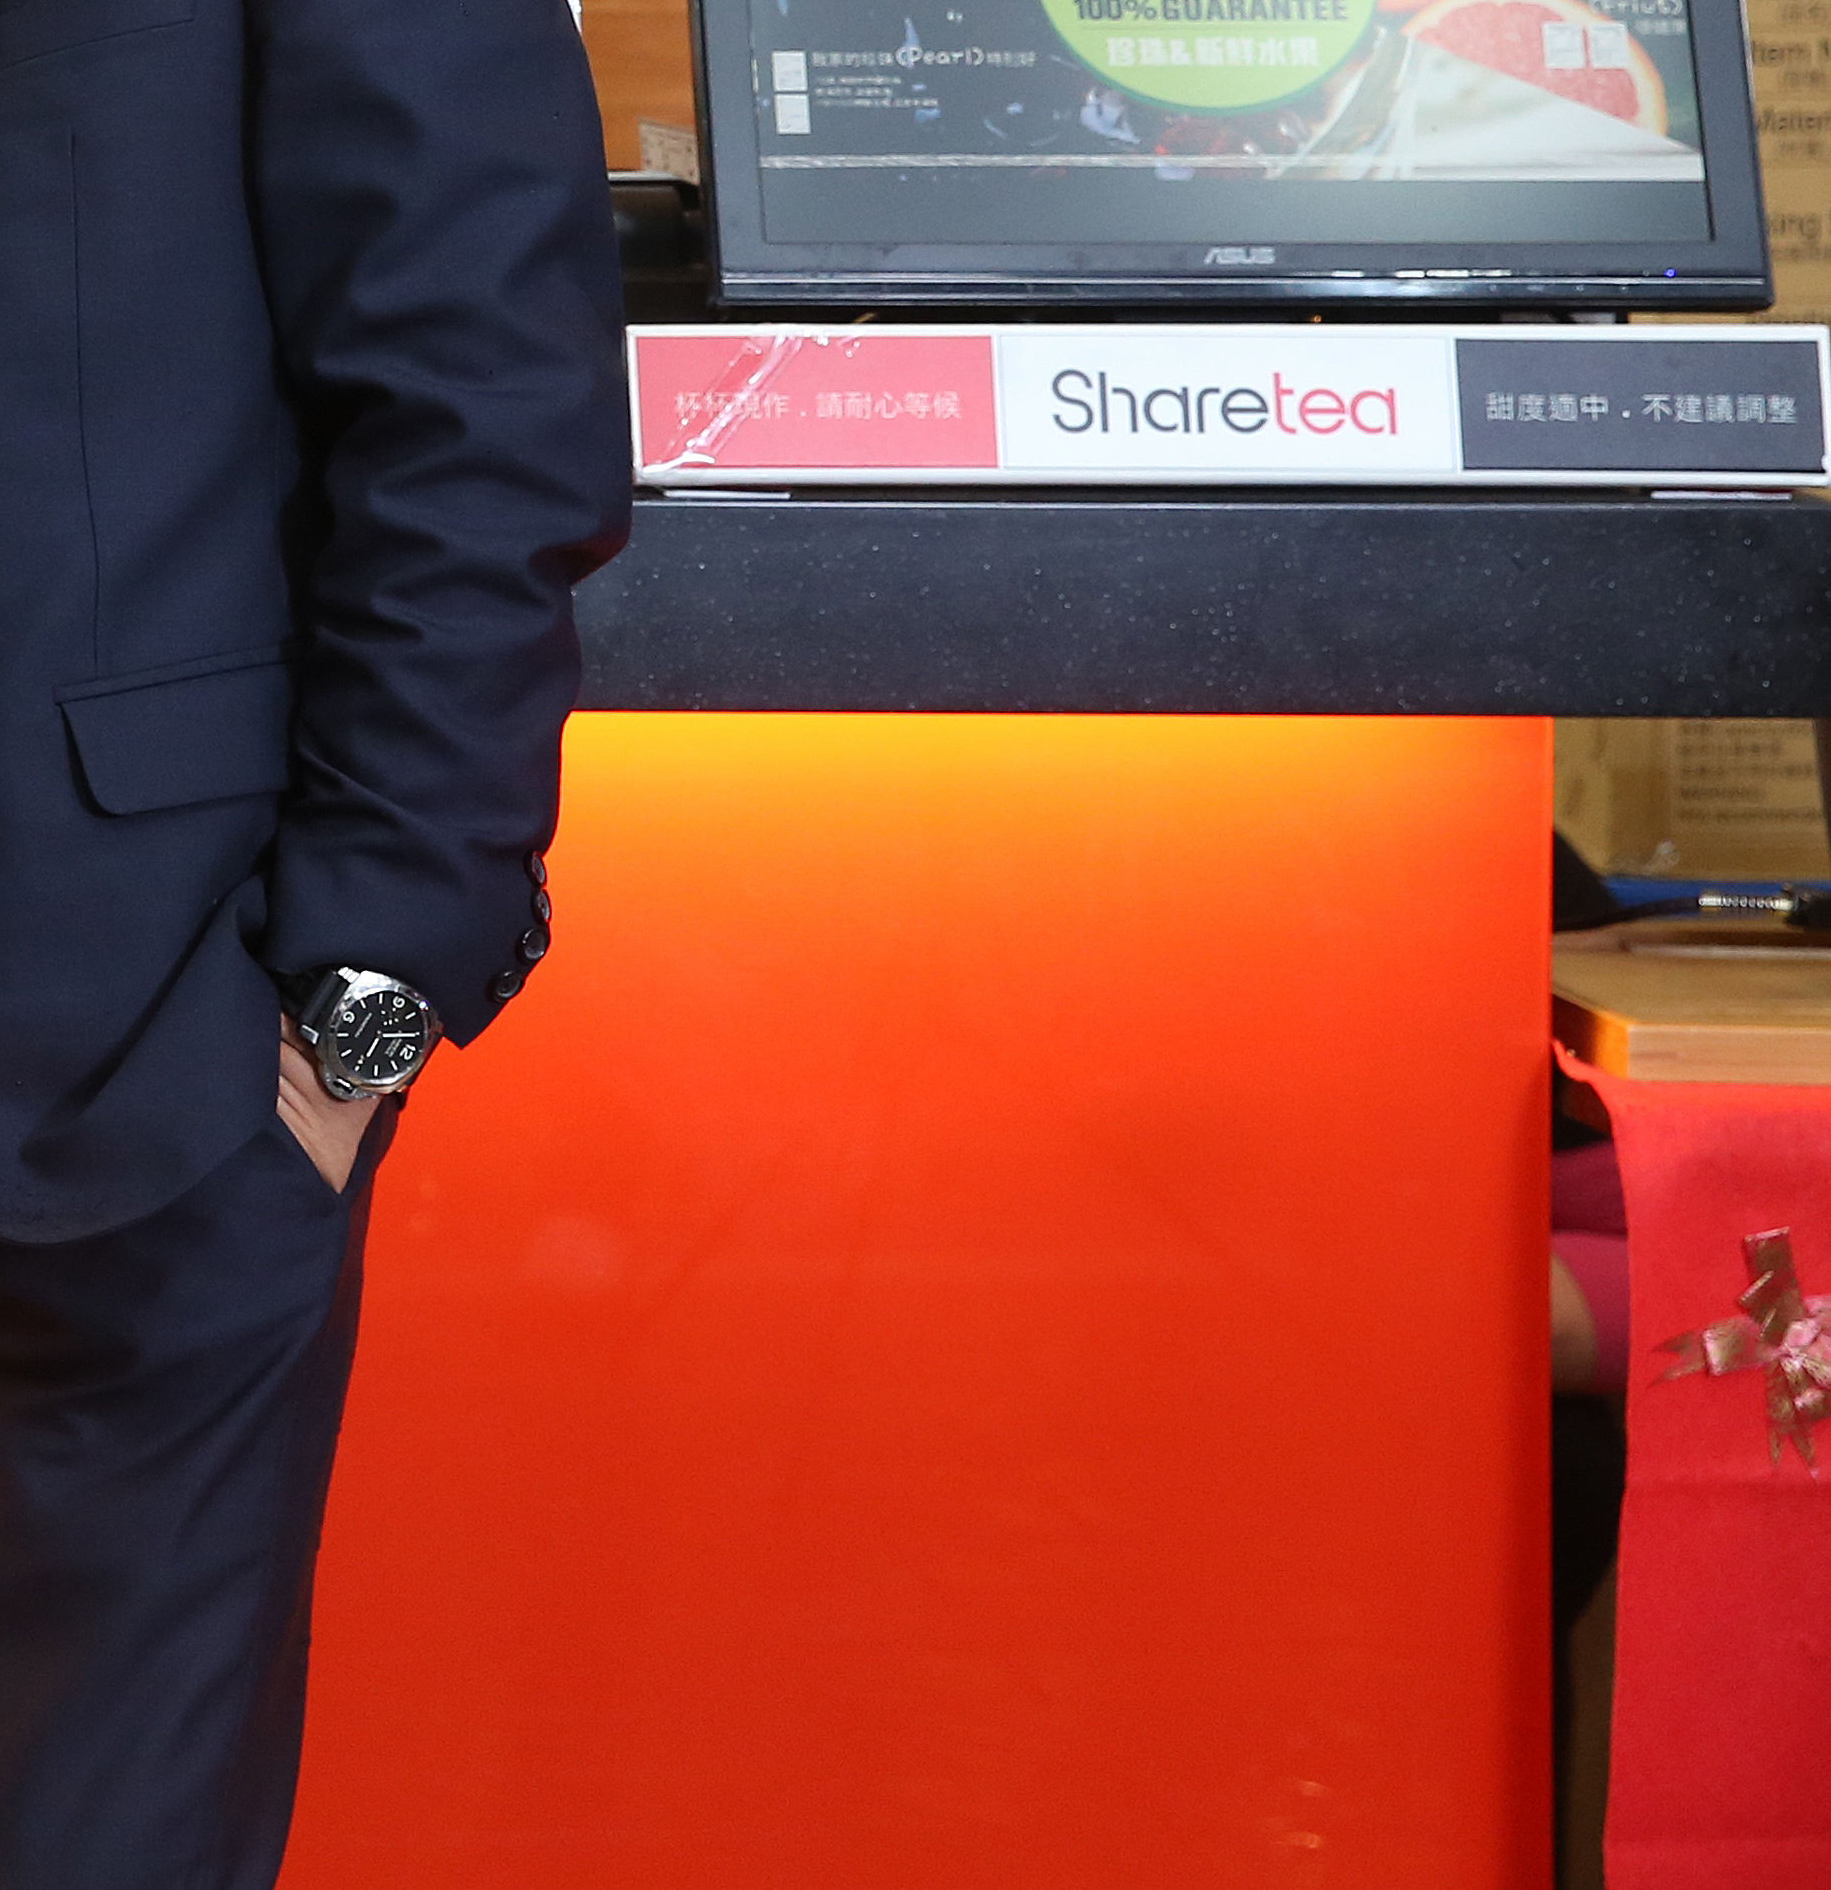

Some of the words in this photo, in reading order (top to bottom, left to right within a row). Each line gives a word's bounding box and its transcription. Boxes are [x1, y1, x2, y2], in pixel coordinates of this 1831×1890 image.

[1106, 36, 1319, 67] 珍珠&新鮮水果
[1203, 246, 1276, 266] ASUS
[1052, 368, 1399, 437] Sharetea
